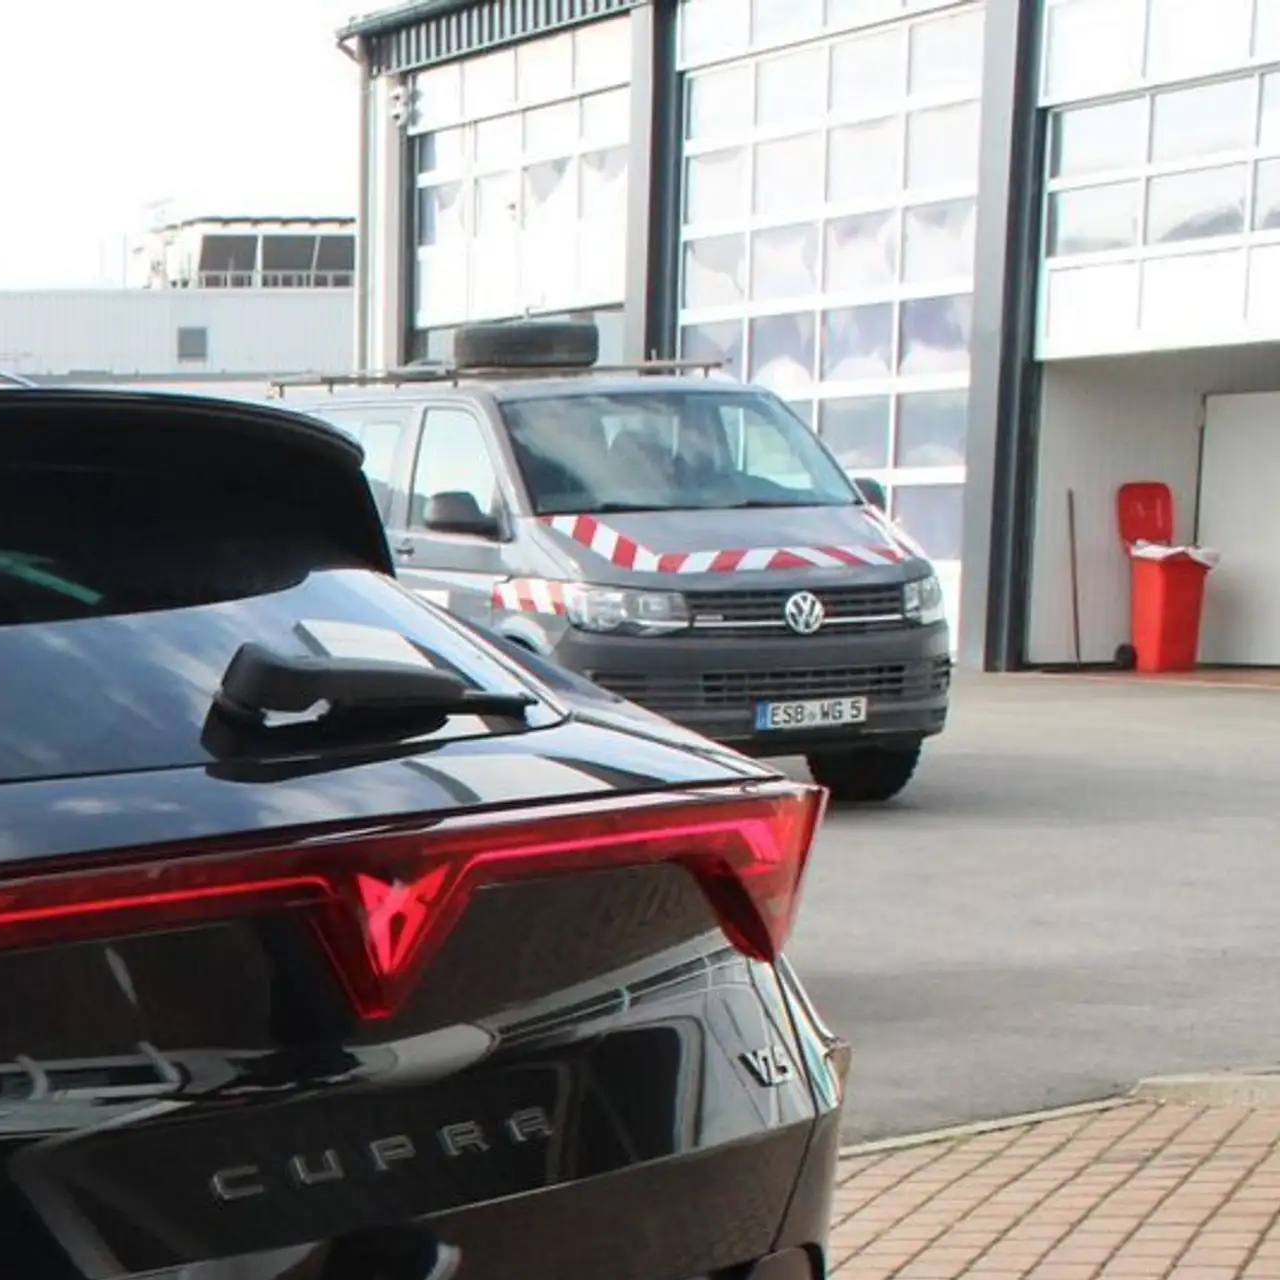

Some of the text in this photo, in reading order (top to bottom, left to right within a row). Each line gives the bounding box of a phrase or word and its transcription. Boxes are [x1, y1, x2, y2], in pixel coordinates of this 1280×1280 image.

[771, 700, 862, 727] ESB WG 5
[211, 1104, 553, 1201] CUPRA
